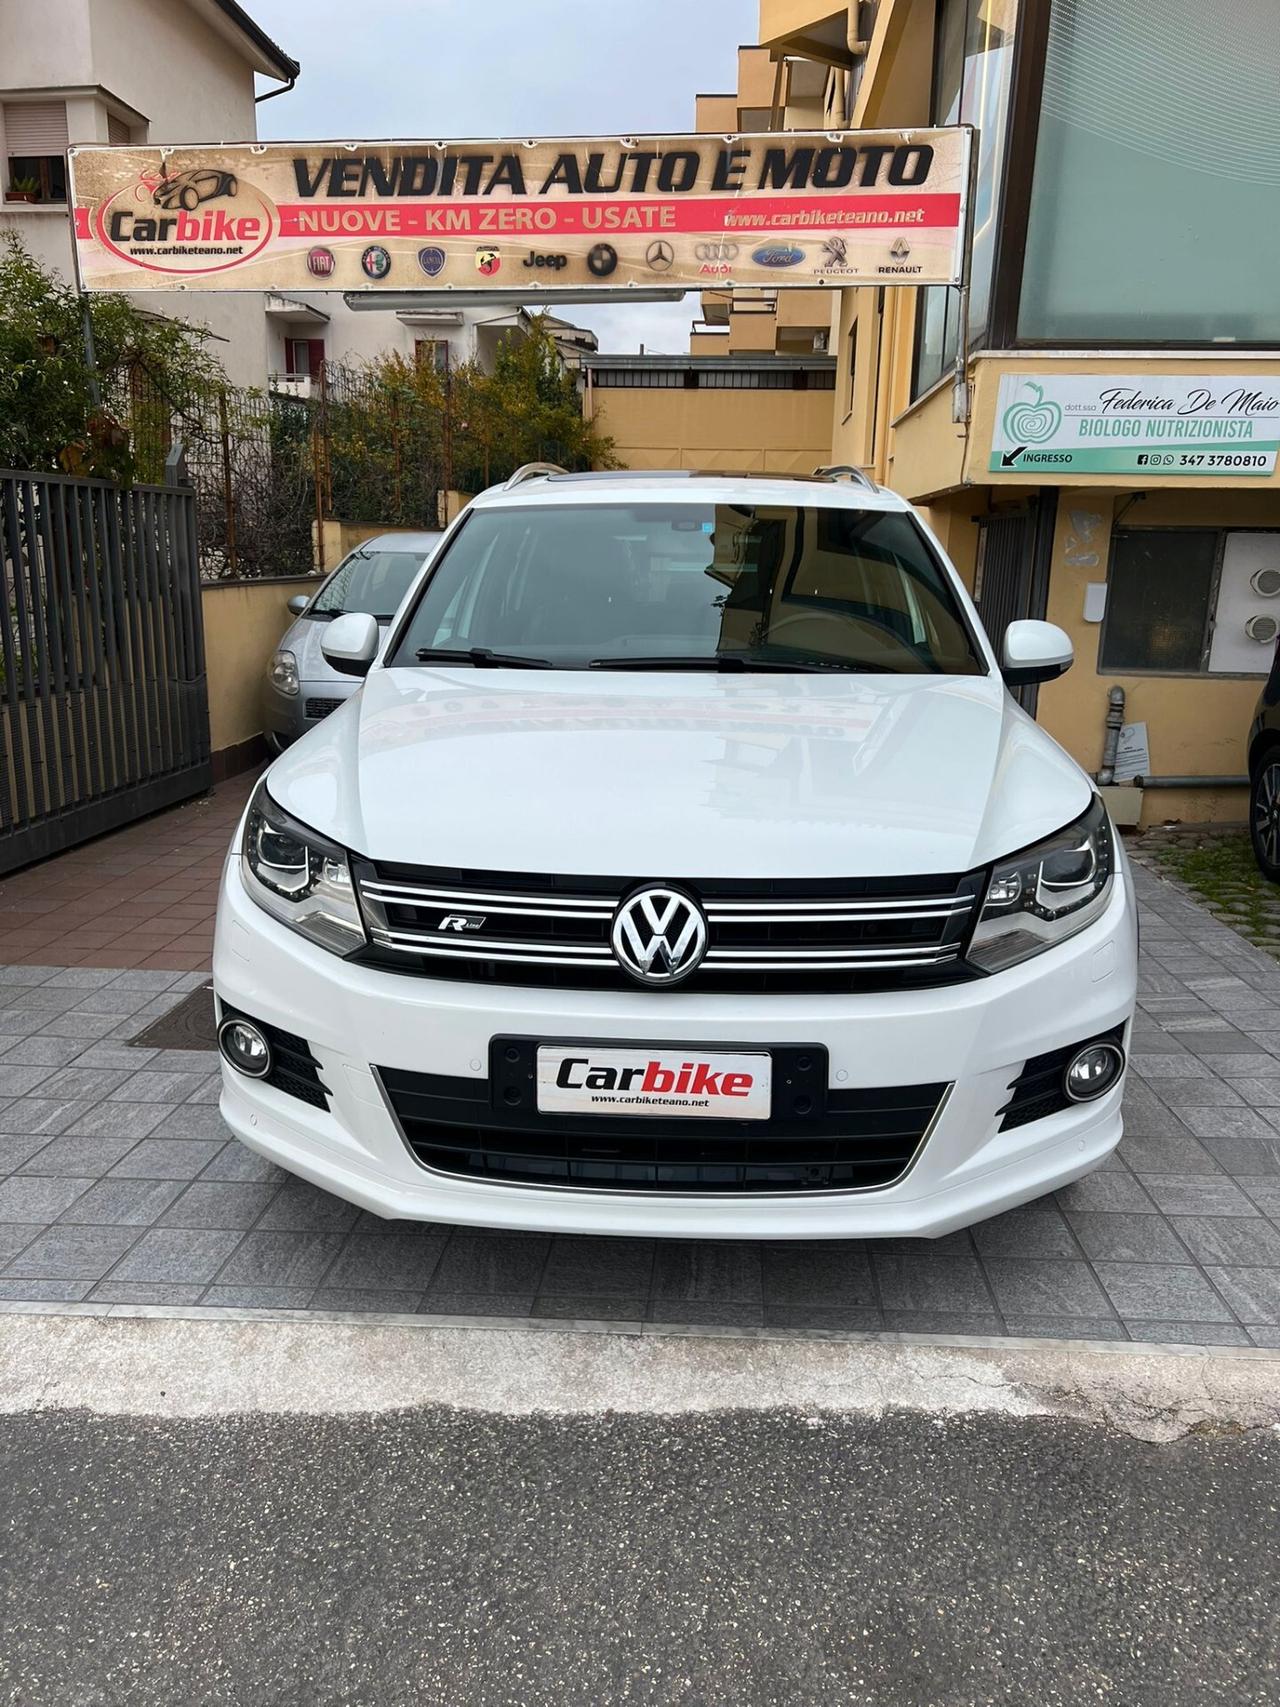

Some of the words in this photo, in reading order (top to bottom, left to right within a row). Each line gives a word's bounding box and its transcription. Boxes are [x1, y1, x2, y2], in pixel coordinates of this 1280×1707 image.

[293, 155, 527, 197] VENDITA
[539, 152, 700, 194] AUTO
[711, 149, 751, 191] E
[758, 145, 934, 189] MOTO
[111, 210, 260, 242] Carbike
[299, 209, 400, 231] NUOVE
[425, 208, 471, 230] KM
[478, 207, 557, 230] ZERO
[582, 206, 676, 228] USATE
[724, 208, 924, 227] www.carbiketeano.net
[130, 246, 243, 255] www.carbiketeano.net
[763, 251, 793, 264] Ford
[523, 251, 567, 270] Jeep
[700, 264, 732, 274] Audi
[878, 266, 923, 274] RENAULT
[1099, 388, 1175, 414] Federica
[1177, 389, 1216, 415] De
[1221, 389, 1279, 416] Maio
[1079, 419, 1141, 437] BIOLOGO
[1145, 419, 1253, 438] NUTRIZIONISTA
[1023, 453, 1073, 463] INGRESSO
[1179, 454, 1205, 466] 347
[1207, 455, 1267, 467] 3780810
[555, 1057, 754, 1097] Carbike
[591, 1094, 710, 1107] www.carbiketeano.net
